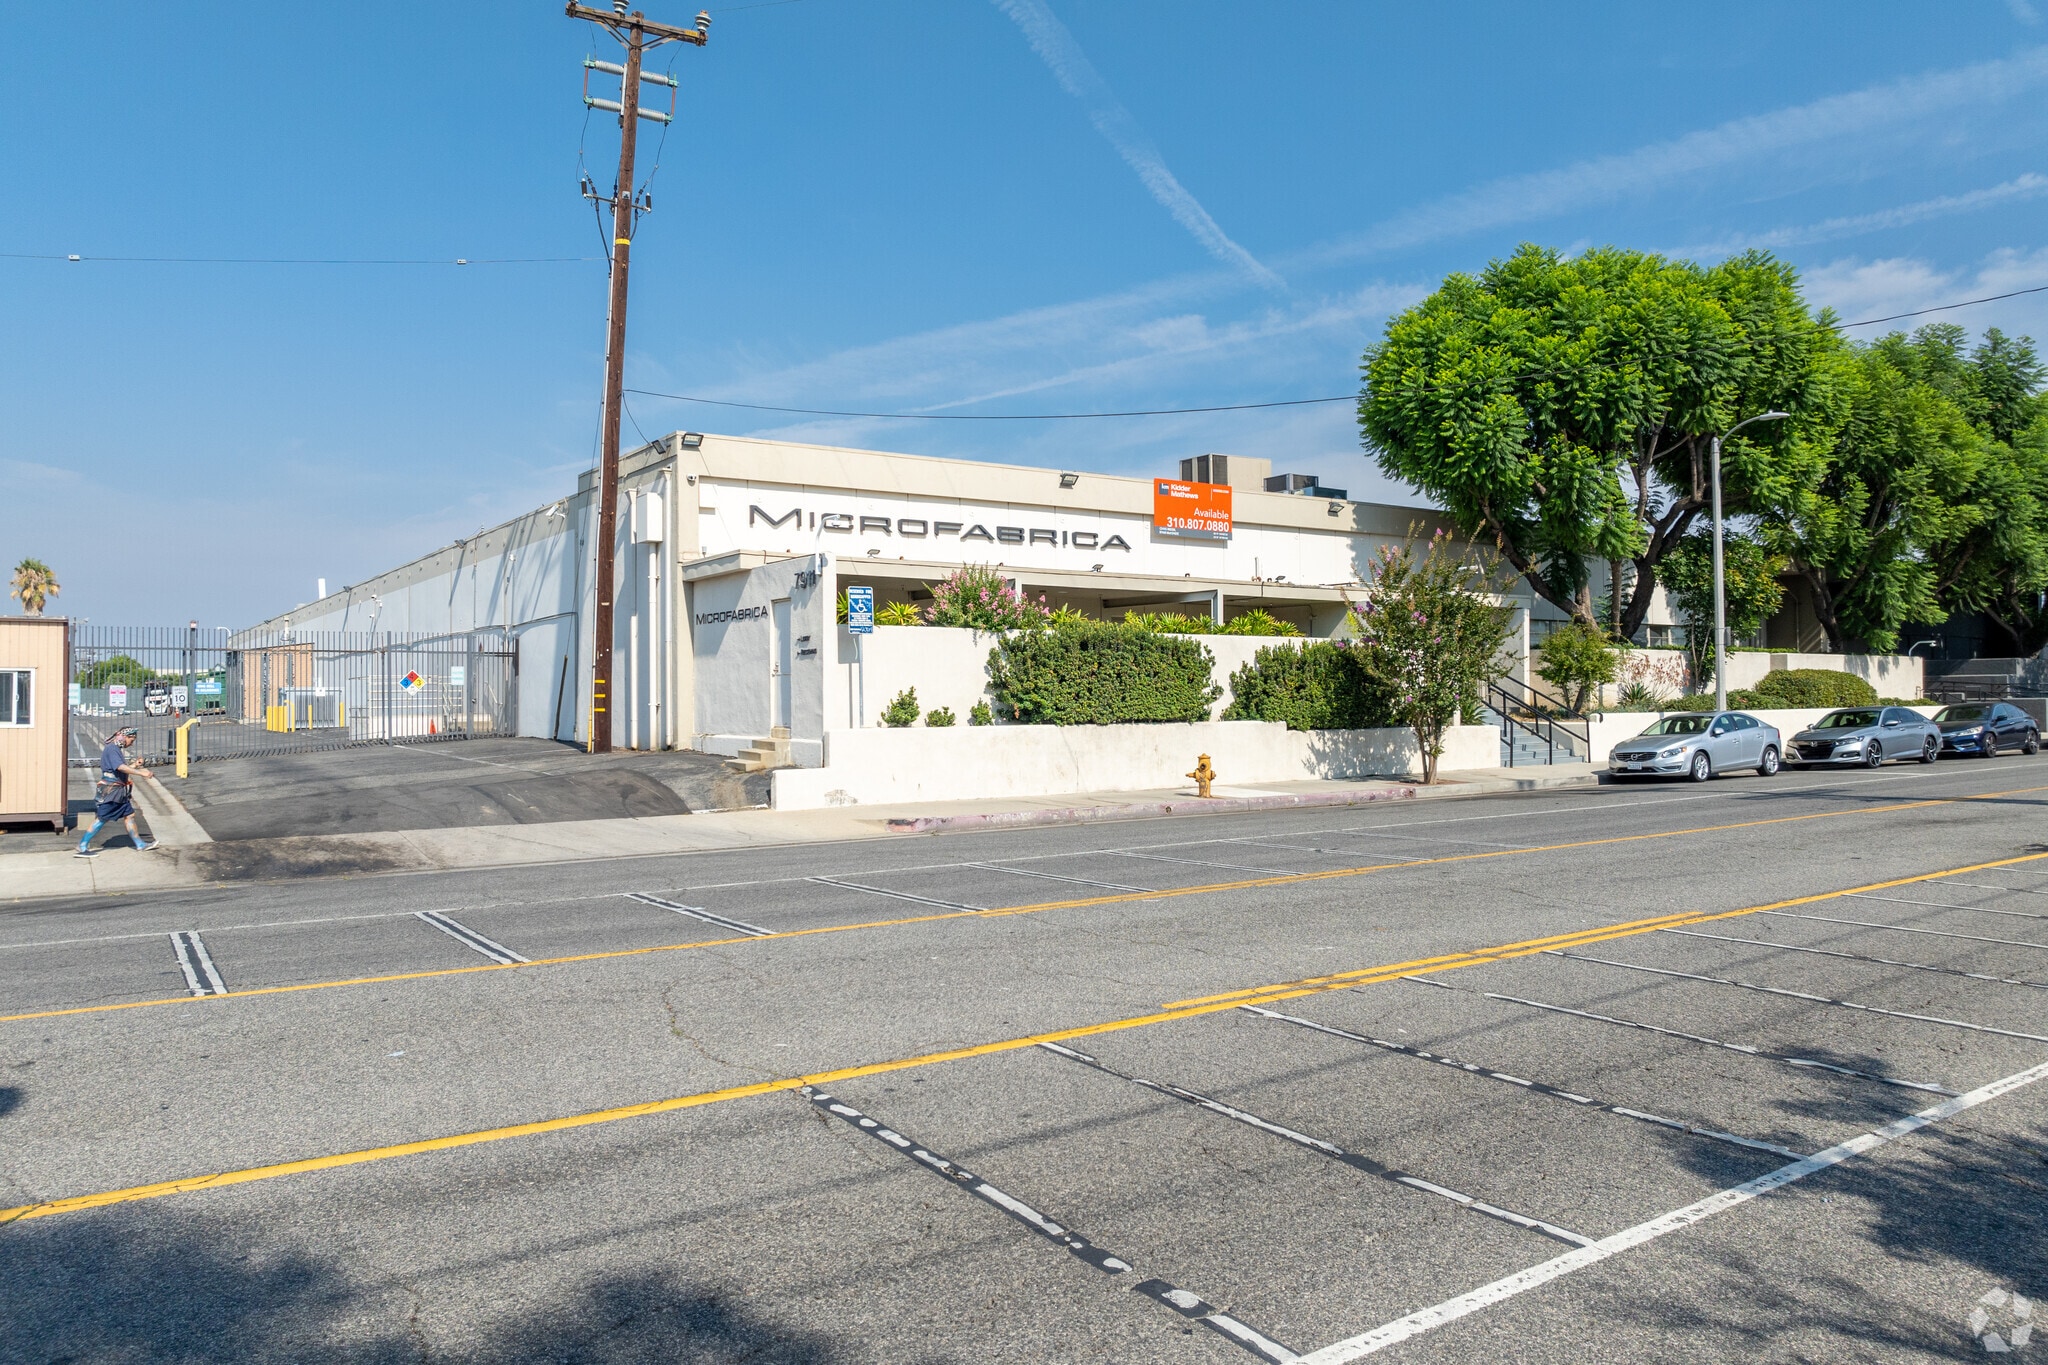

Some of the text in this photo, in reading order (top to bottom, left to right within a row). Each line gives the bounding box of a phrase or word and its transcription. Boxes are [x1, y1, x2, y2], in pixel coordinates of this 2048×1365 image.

[1171, 484, 1191, 492] Kidder
[1171, 490, 1198, 499] Mathews
[1193, 507, 1228, 519] Available
[749, 504, 1132, 552] MICROFABRICA
[1166, 516, 1229, 532] 310.807.0880
[696, 605, 768, 625] MICROFABRICA
[175, 694, 186, 702] 10
